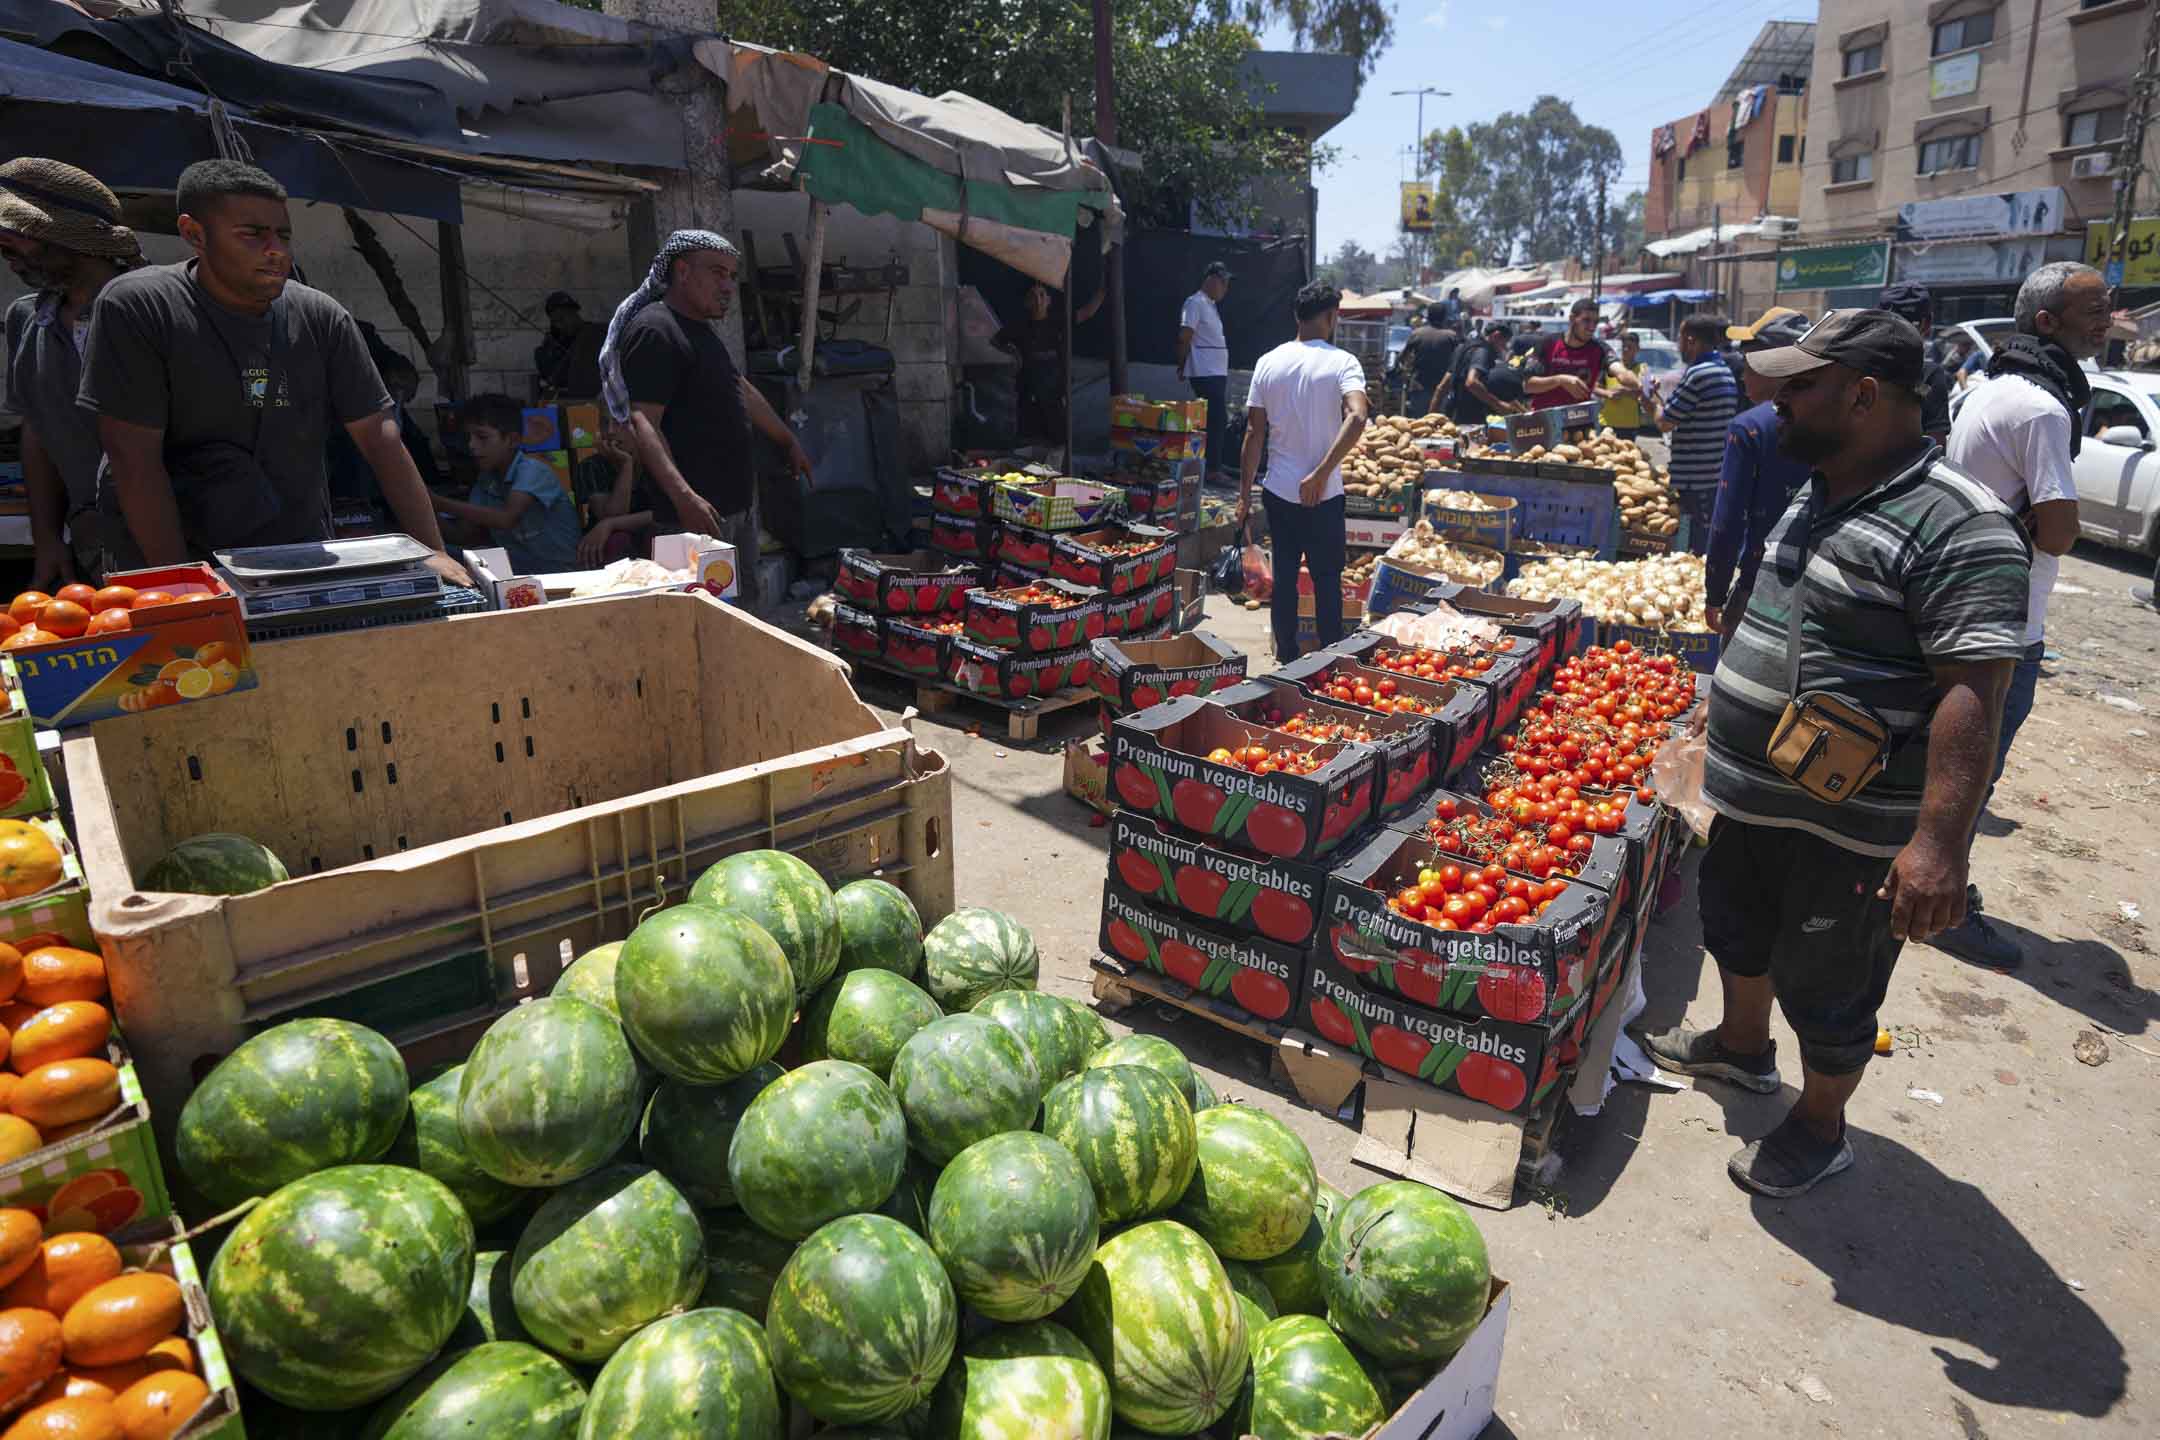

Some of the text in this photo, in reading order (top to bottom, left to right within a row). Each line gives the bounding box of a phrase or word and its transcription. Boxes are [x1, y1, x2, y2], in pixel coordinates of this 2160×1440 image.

[889, 574, 977, 587] Premium vegetables
[1030, 602, 1103, 625] Premium vegetables
[48, 646, 118, 670] הדרי
[1010, 656, 1051, 673] Premium
[1133, 663, 1244, 684] Premium vegetables
[1117, 736, 1308, 812] Premium vegetables
[1117, 822, 1313, 899] Premium vegetables
[1108, 892, 1289, 979] Premium vegetables
[1333, 893, 1542, 967] Premium vegetables
[1312, 967, 1527, 1065] Premium vegetables
